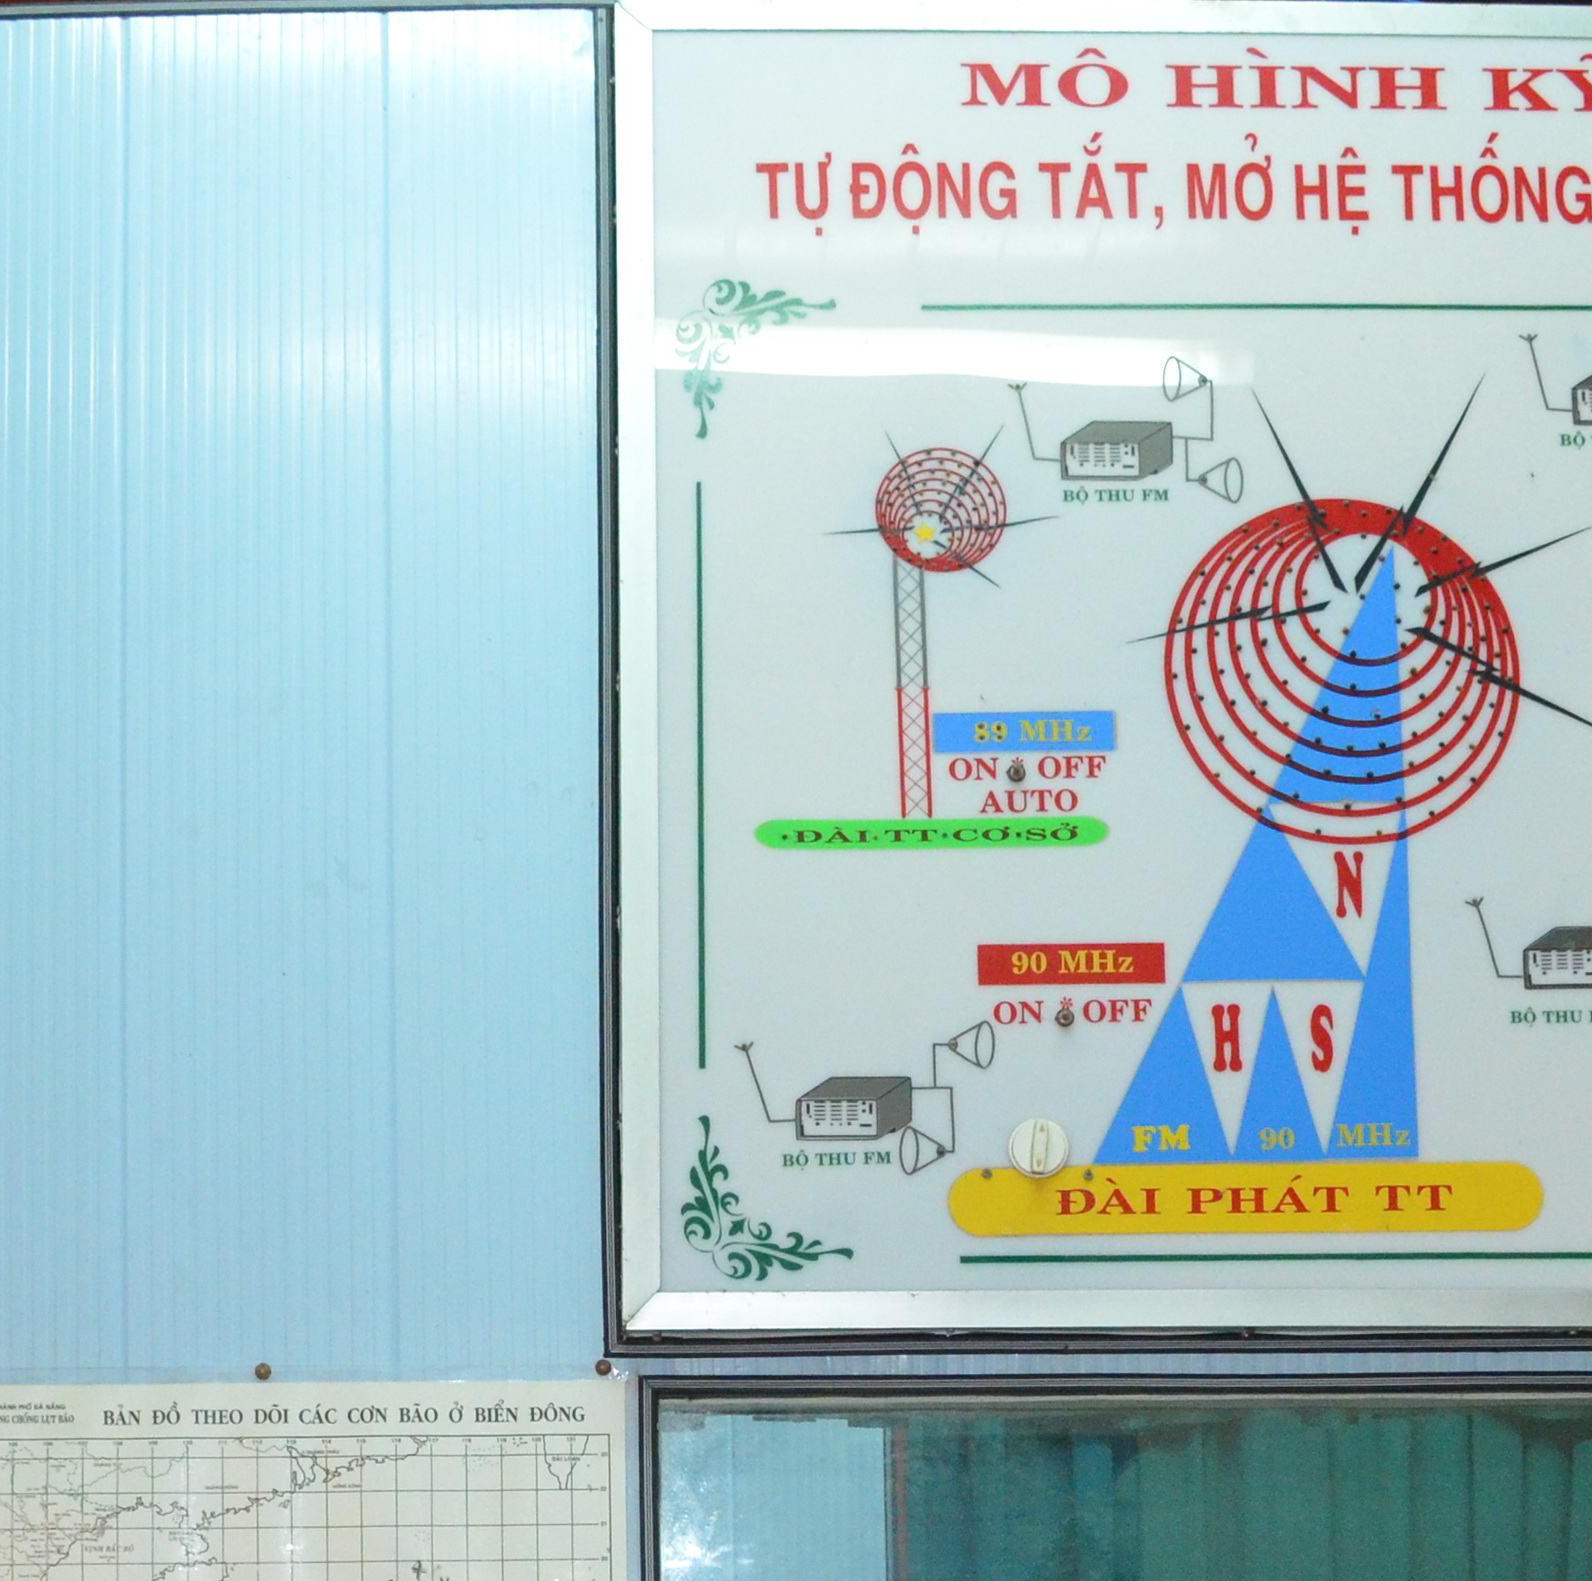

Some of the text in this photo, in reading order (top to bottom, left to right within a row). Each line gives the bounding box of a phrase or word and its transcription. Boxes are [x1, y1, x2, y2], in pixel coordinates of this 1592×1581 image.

[961, 48, 1129, 108] MÔ
[1165, 47, 1448, 110] HÌNH
[755, 153, 832, 235] TỰ
[848, 144, 1018, 235] ĐỘNG
[1038, 131, 1165, 230] TẮT,
[1186, 133, 1274, 222] MỞ
[1294, 148, 1371, 235] HỆ
[1560, 431, 1586, 449] BỘ
[1063, 486, 1169, 505] BỘ THU FM
[974, 719, 1092, 742] 89 MHz
[948, 755, 1106, 781] ON OFF
[979, 789, 1079, 814] AUTO
[884, 829, 938, 842] TT
[1334, 850, 1365, 917] N
[1011, 948, 1134, 974] 90 MHz
[993, 998, 1152, 1025] ON OFF
[1511, 1007, 1536, 1027] BỘ
[1543, 1010, 1582, 1023] THU
[1211, 1004, 1334, 1072] H S
[1131, 1123, 1411, 1152] FM 90 MHz
[782, 1150, 891, 1171] BỘ THU FM
[1056, 1174, 1454, 1217] ĐÀI PHÁT TT
[103, 1399, 586, 1426] BẢN ĐỒ THEO DÕI CÁC CƠN BÃO Ở BIỂN ĐÔNG
